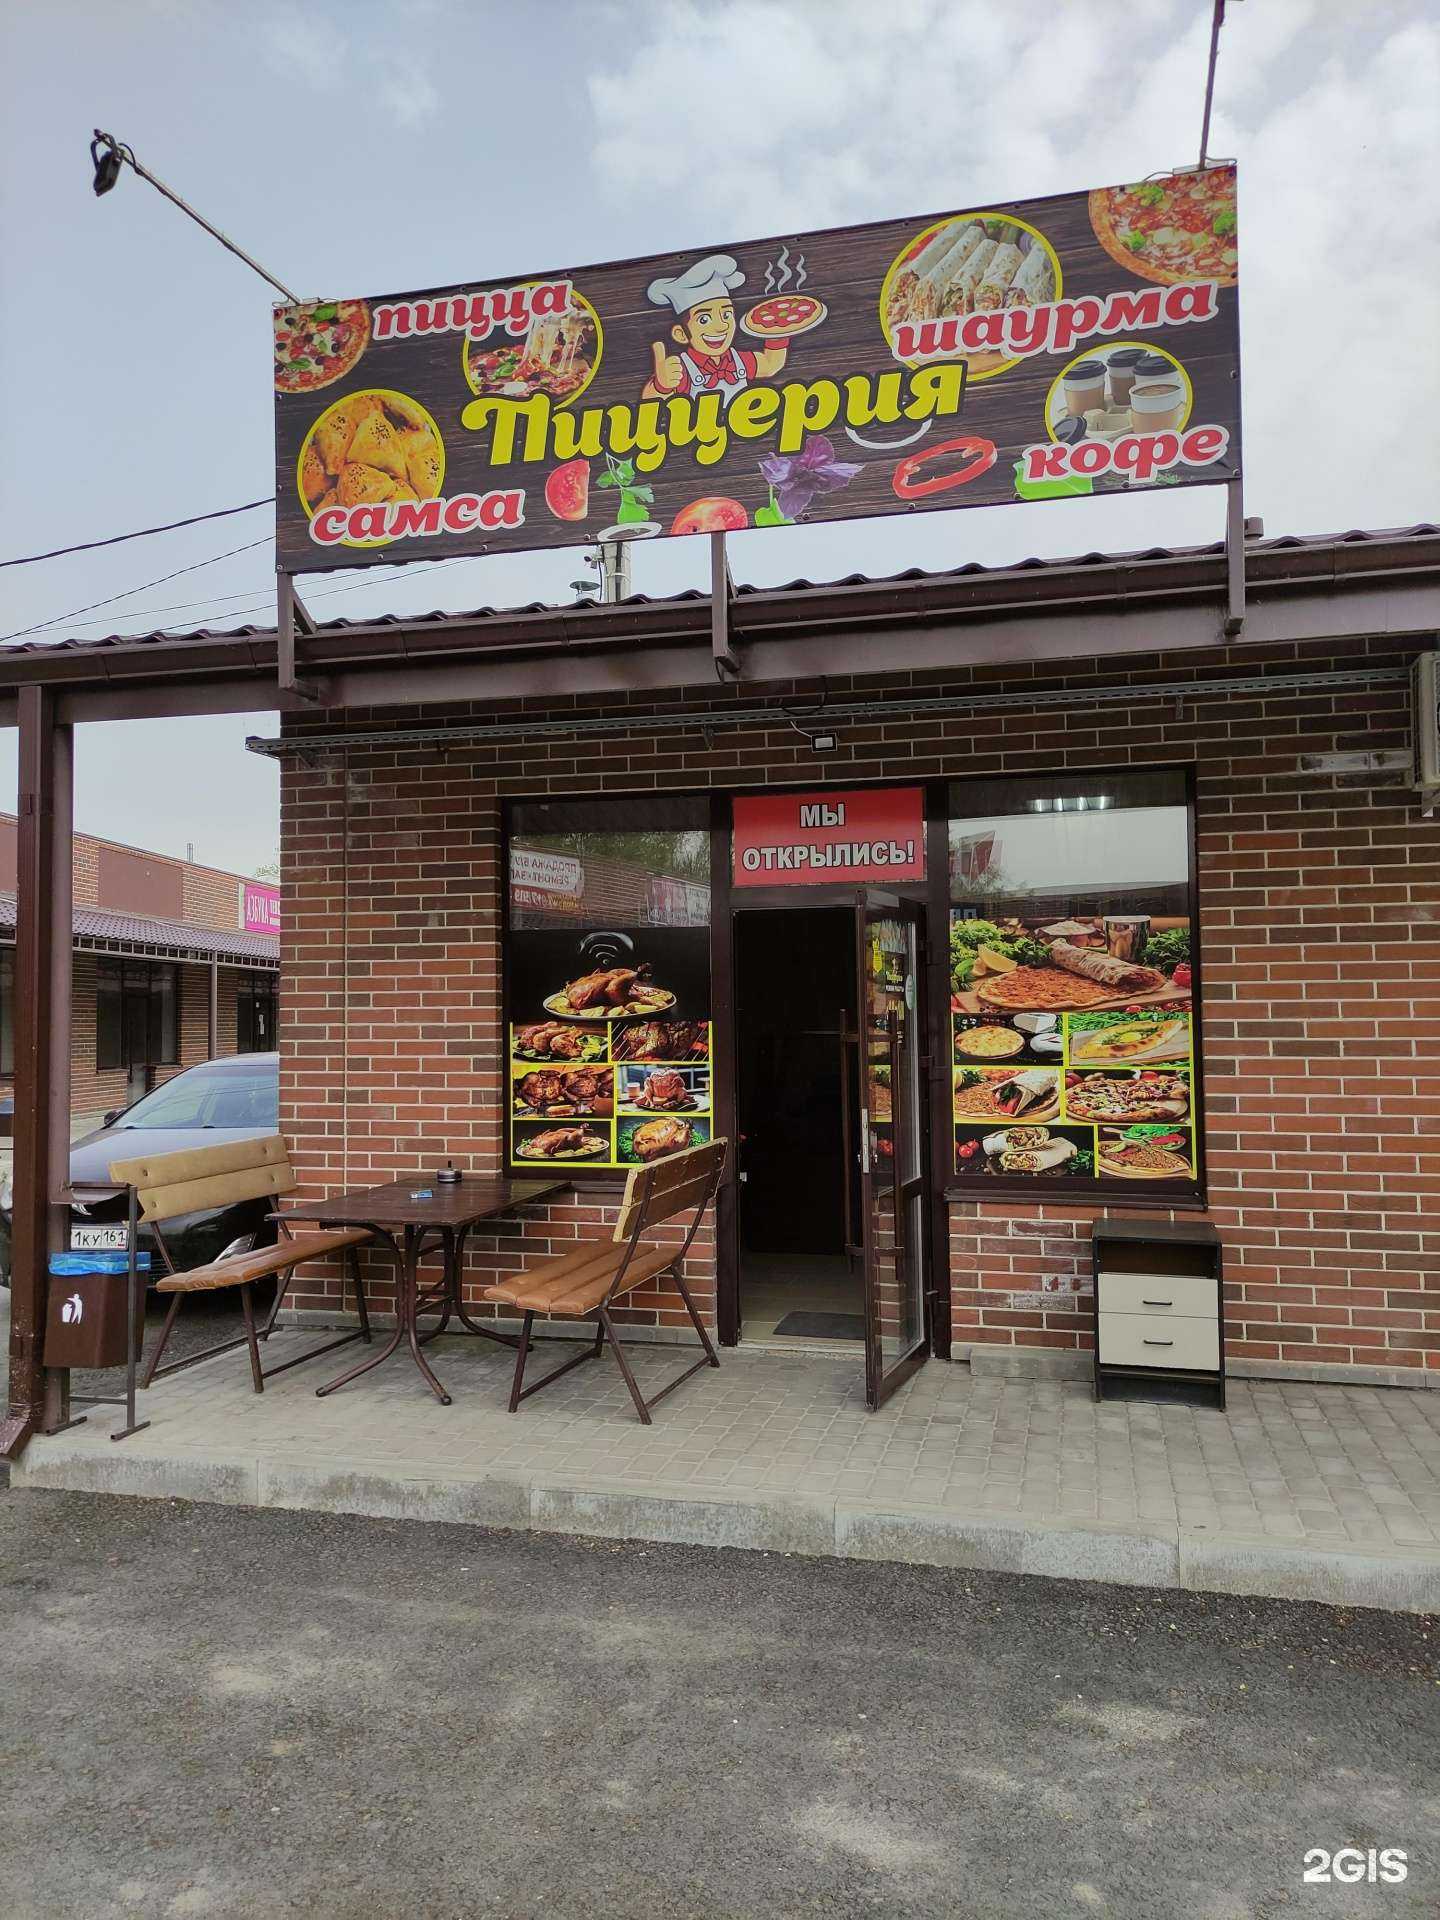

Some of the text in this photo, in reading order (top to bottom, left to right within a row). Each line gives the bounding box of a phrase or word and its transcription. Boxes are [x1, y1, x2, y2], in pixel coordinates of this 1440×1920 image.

[375, 281, 571, 339] пицца
[894, 281, 1216, 357] шаурма
[461, 362, 964, 473] Пиццерия
[1025, 427, 1227, 481] кофе
[311, 490, 524, 544] самса
[800, 803, 845, 828] МЫ
[742, 840, 915, 871] ОТКРЫЛИСЬ!
